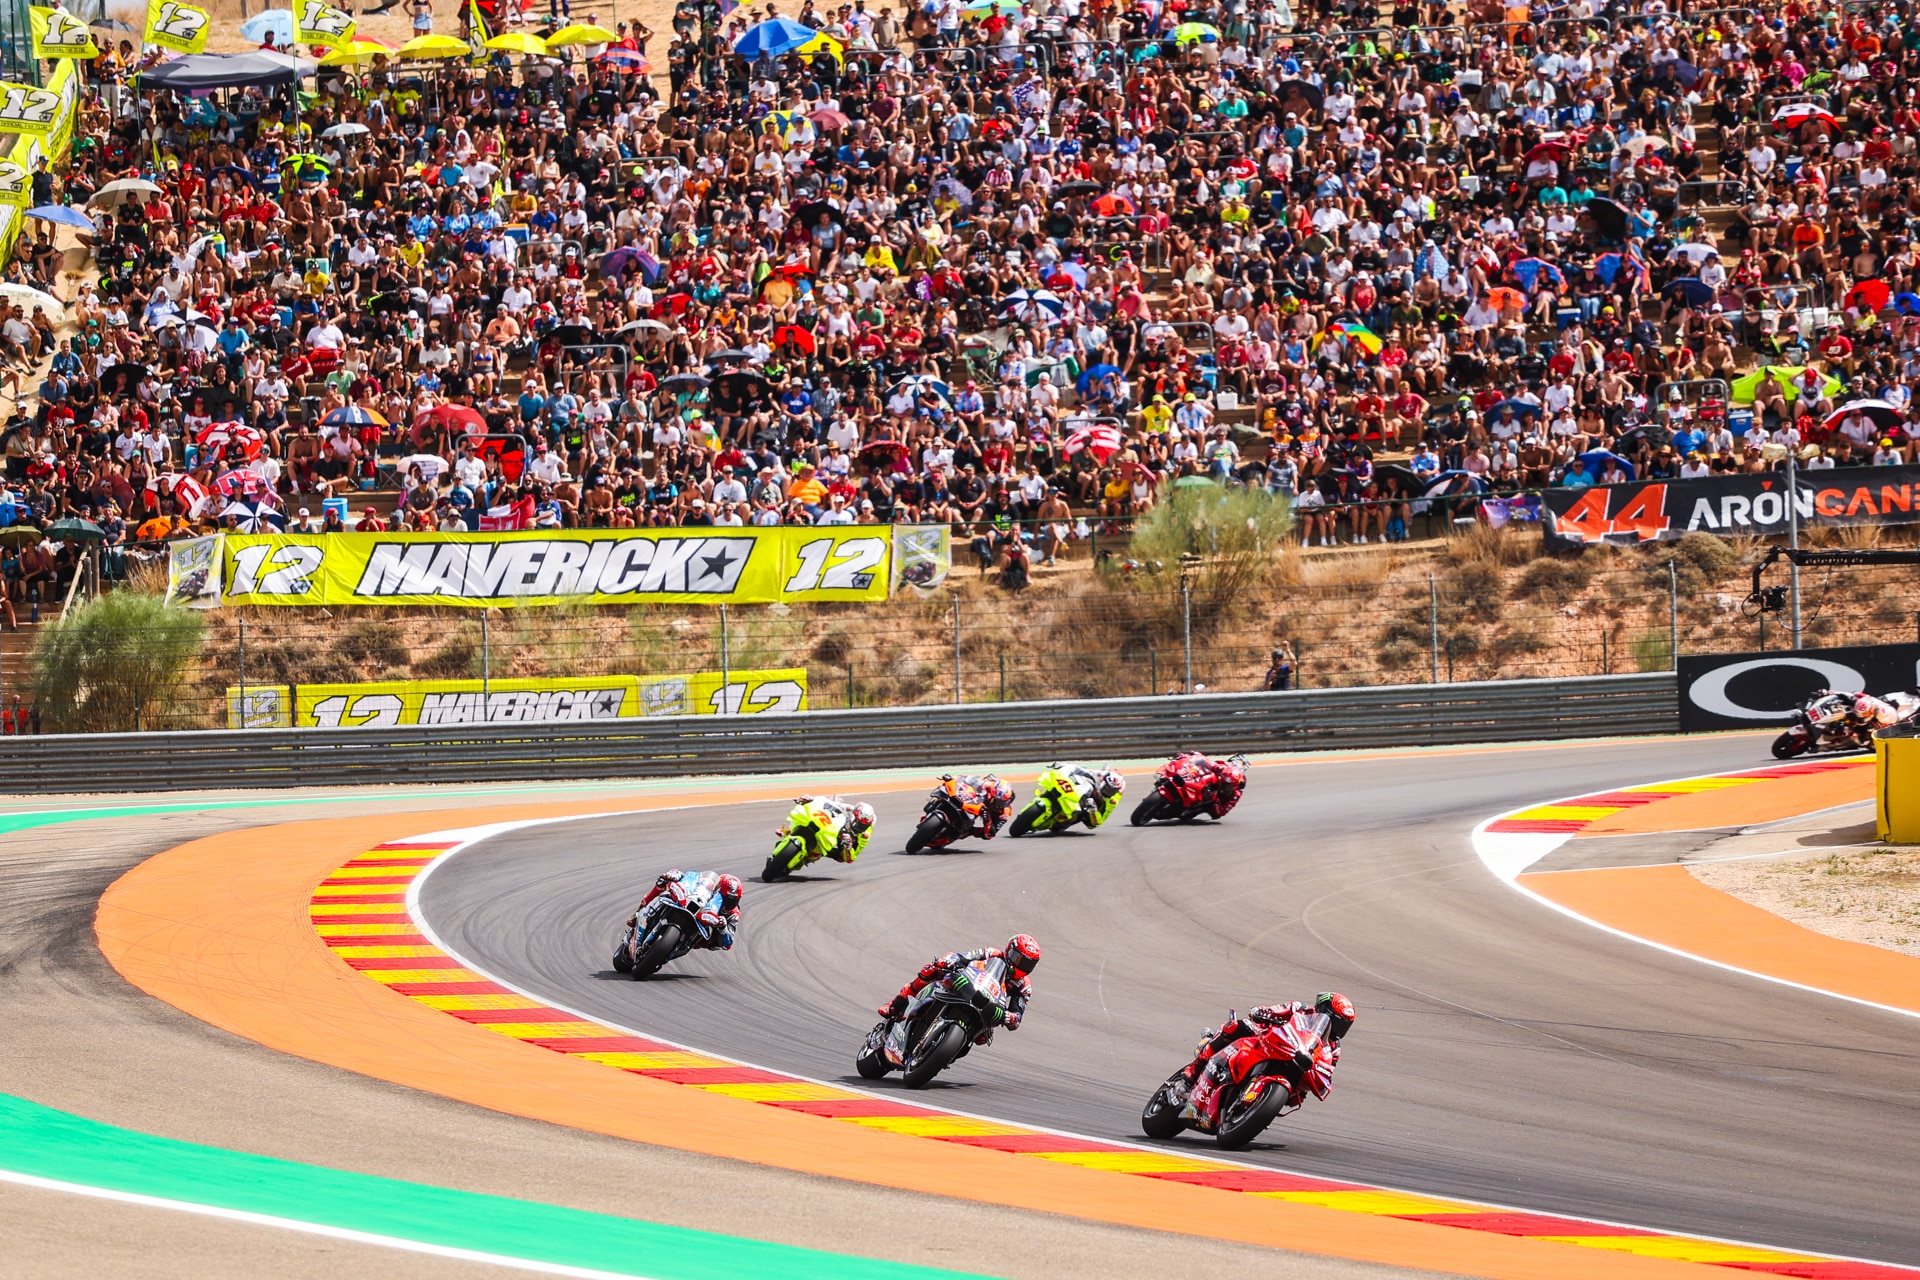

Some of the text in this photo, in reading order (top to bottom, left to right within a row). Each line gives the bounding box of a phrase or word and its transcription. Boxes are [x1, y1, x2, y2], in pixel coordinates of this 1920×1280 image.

[42, 13, 89, 45] 12
[154, 2, 207, 40] 12
[300, 2, 353, 37] 12
[0, 88, 60, 122] 12
[0, 162, 26, 192] 2
[1556, 484, 1671, 543] 44
[1815, 484, 1920, 517] CAN
[181, 540, 215, 569] 12
[906, 530, 940, 553] 12
[226, 537, 887, 598] 12 MAVERICK 12
[242, 690, 278, 718] 12
[311, 689, 600, 726] 12 MAVERICK
[648, 681, 684, 708] 12
[709, 680, 805, 714] 12
